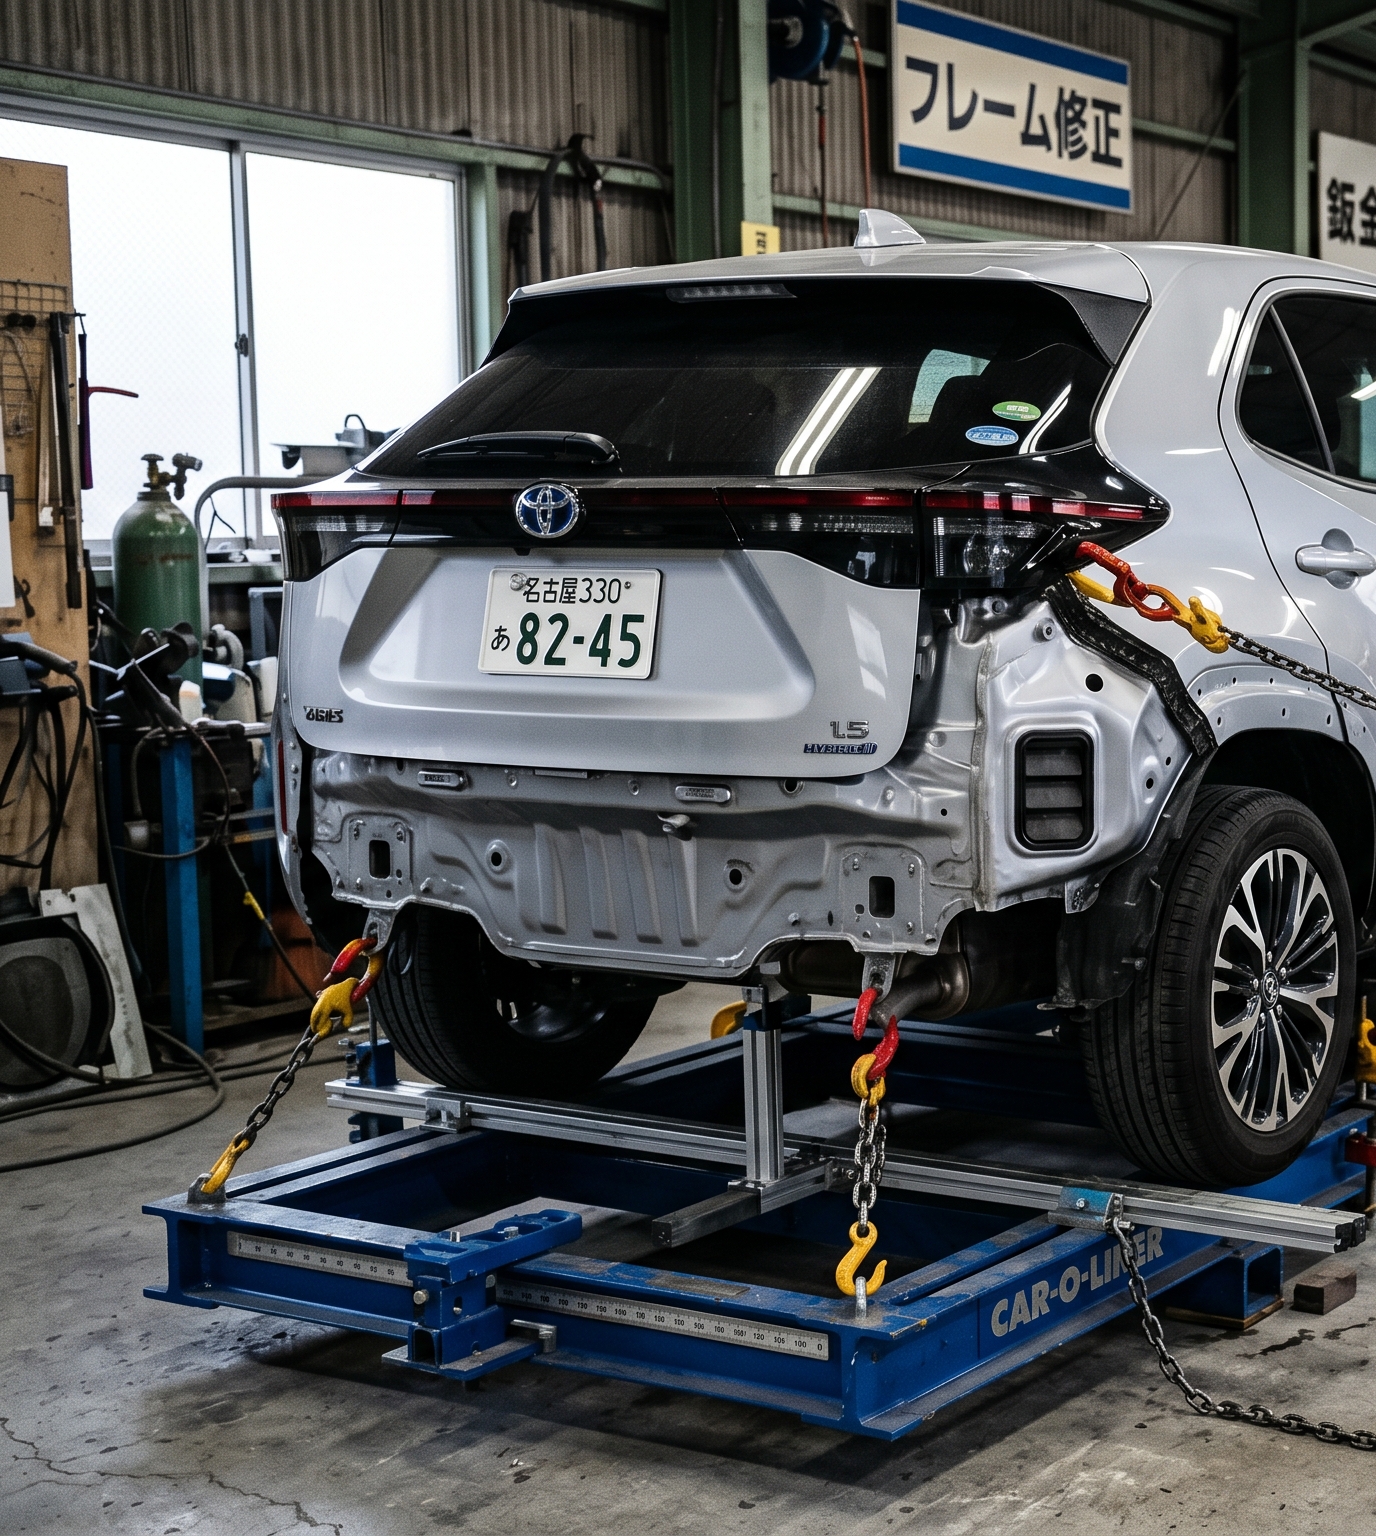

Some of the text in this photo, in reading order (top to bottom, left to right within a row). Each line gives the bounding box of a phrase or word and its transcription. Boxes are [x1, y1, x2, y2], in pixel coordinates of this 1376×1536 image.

[906, 55, 1123, 169] フレーム修正
[491, 612, 645, 668] あ 82-45
